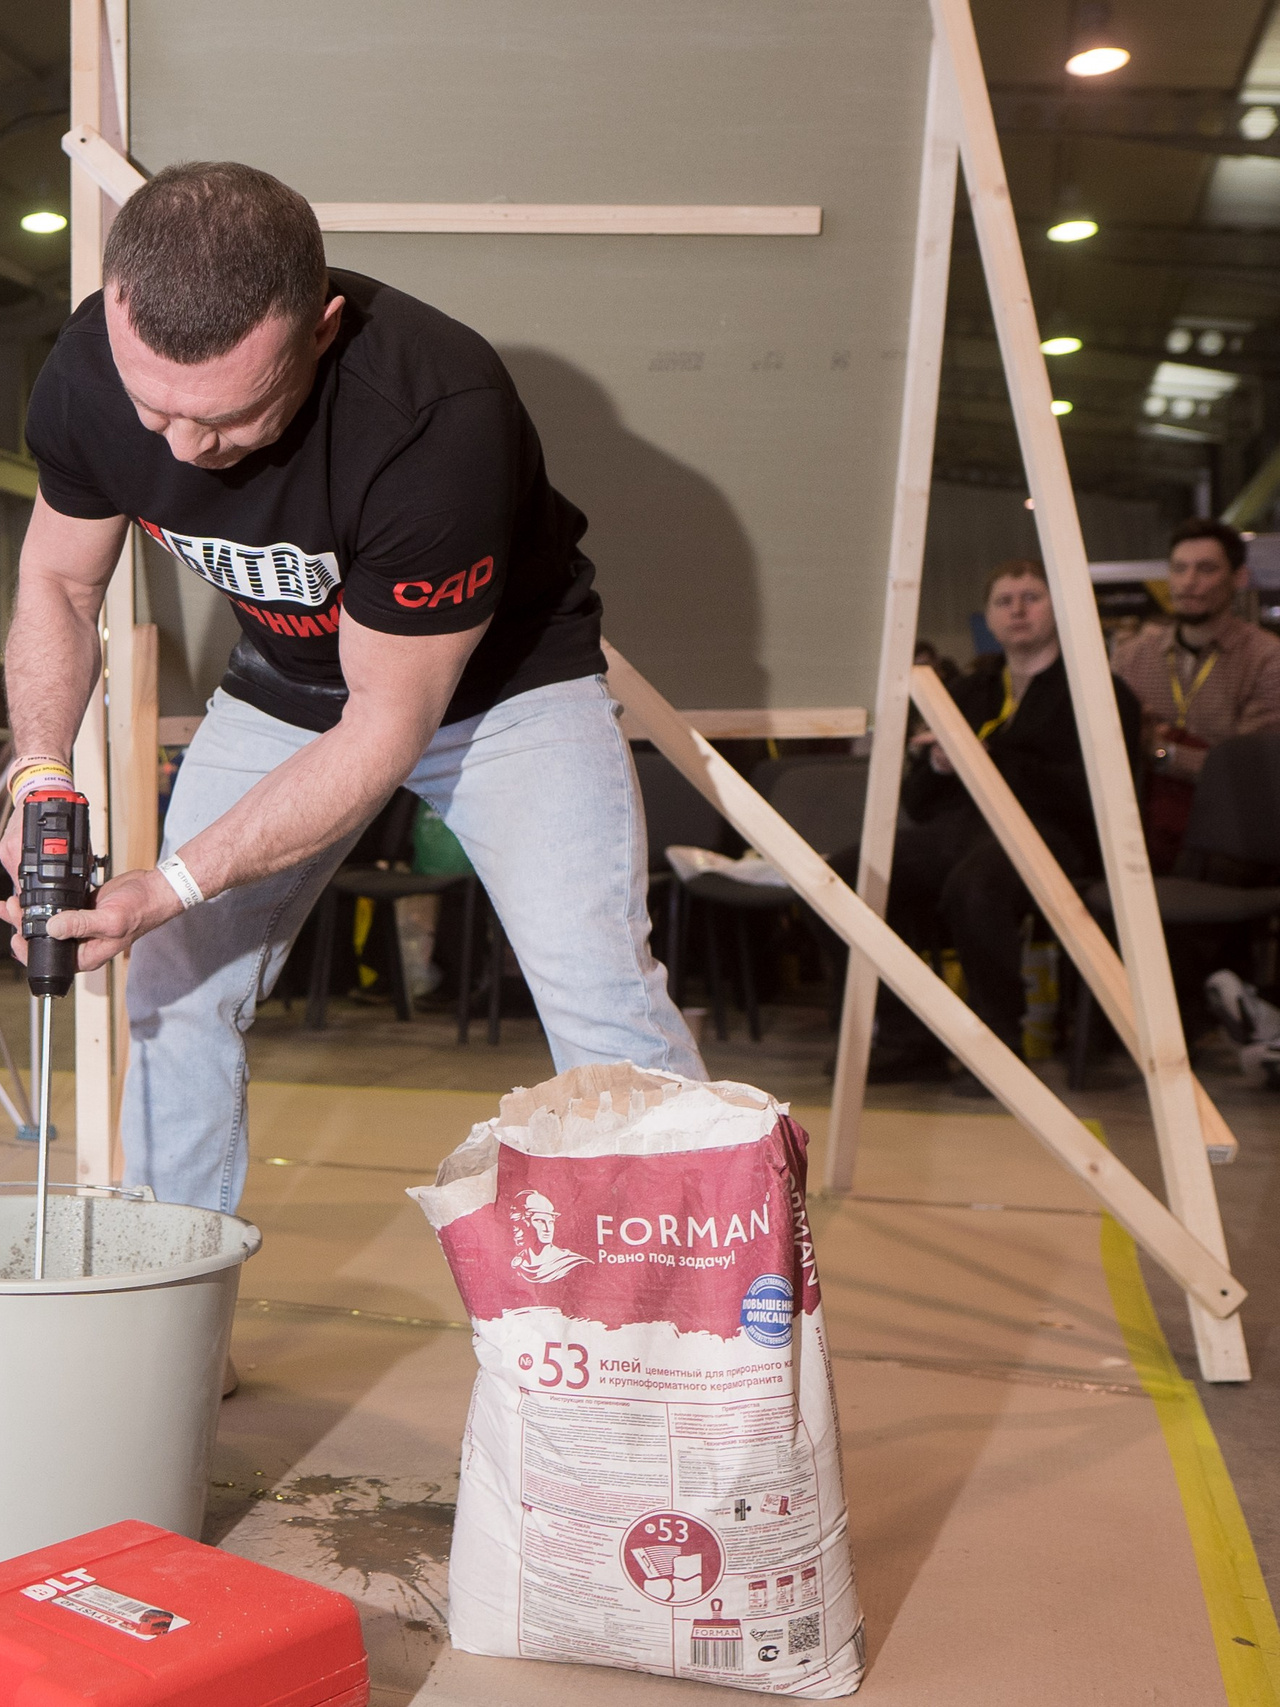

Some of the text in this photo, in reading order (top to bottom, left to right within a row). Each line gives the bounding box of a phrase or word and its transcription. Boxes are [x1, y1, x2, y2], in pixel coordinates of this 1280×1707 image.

[170, 535, 336, 603] БИТВА
[596, 1203, 770, 1248] FORMAN
[598, 1249, 735, 1271] Ровно под задачу!
[746, 1311, 793, 1326] ФИКСАЦИ
[538, 1342, 590, 1389] 53
[600, 1358, 641, 1374] клей
[645, 1367, 702, 1379] цементный
[705, 1369, 724, 1380] для
[726, 1361, 782, 1381] природного
[600, 1374, 783, 1391] и крупноформатного керамогранита
[657, 1518, 689, 1543] 53
[694, 1628, 739, 1636] FORMAN
